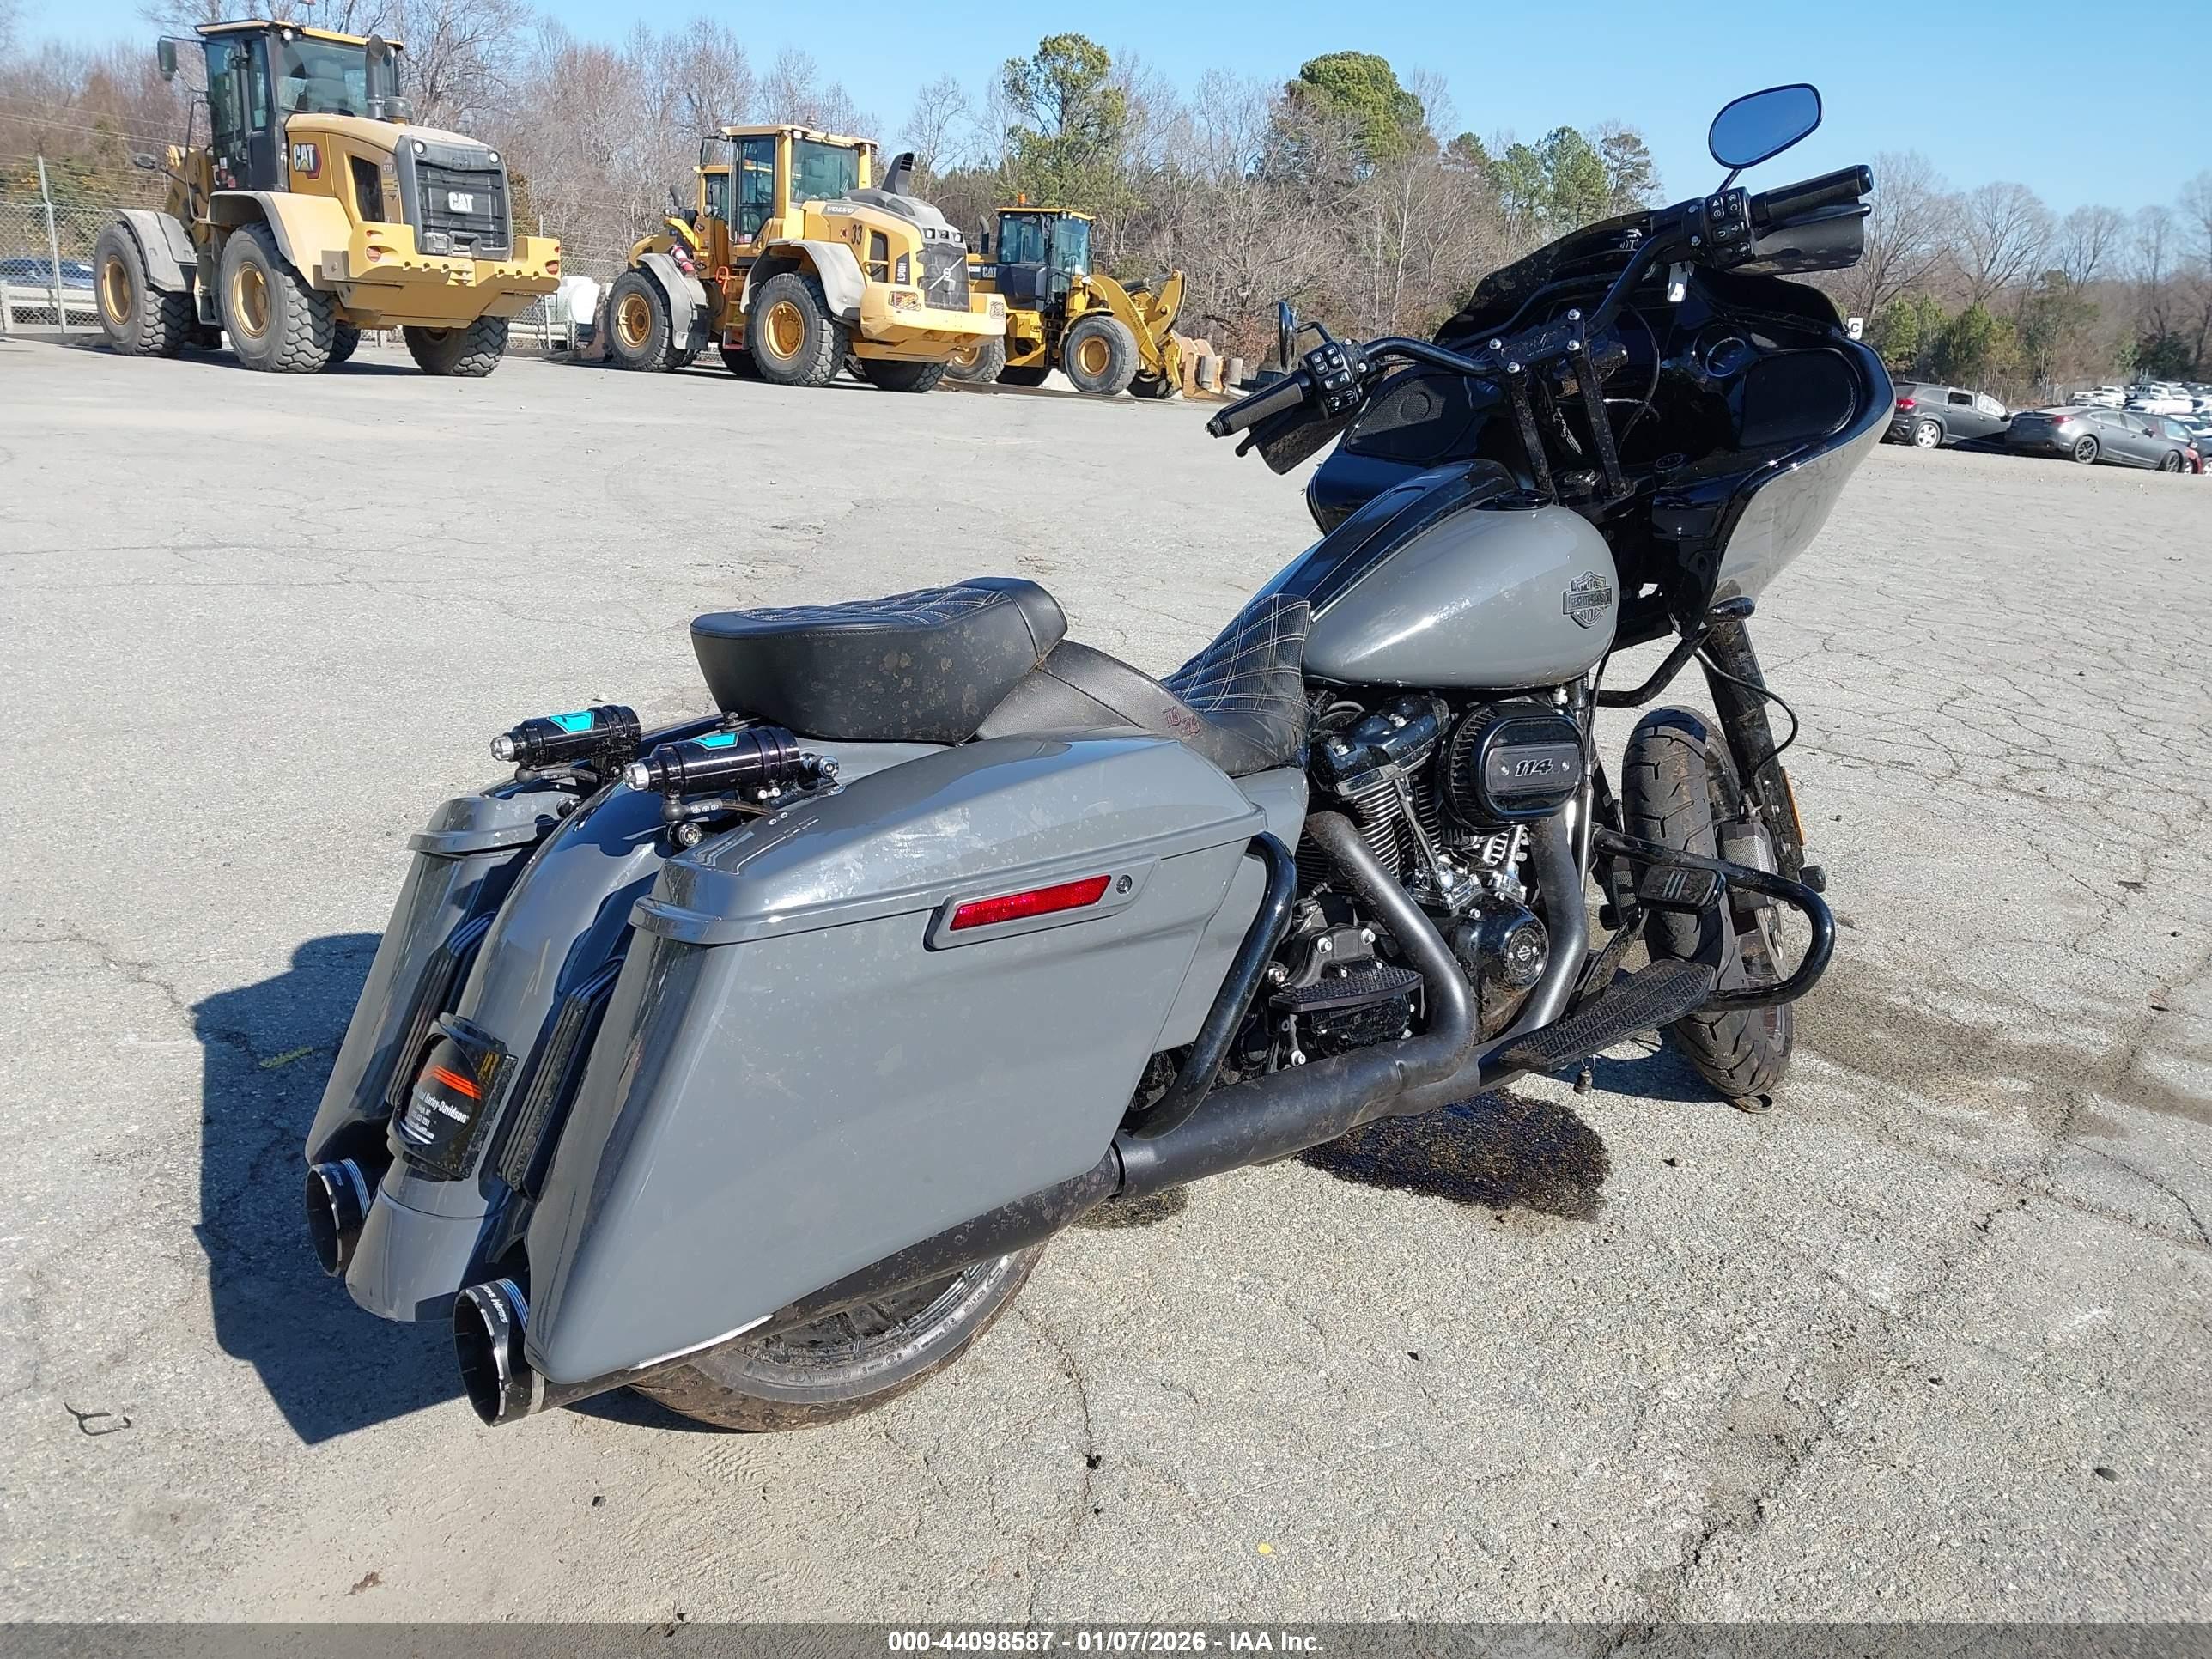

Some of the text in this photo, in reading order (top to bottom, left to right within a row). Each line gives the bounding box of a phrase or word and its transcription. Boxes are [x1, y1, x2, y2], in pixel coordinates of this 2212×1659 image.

[293, 144, 314, 171] CAT
[448, 191, 474, 213] CAT
[827, 205, 854, 214] VOLVO
[851, 224, 863, 246] 33
[896, 262, 907, 282] L90H
[982, 266, 997, 278] CAT
[1850, 323, 1860, 333] C
[1514, 757, 1554, 777] 114
[963, 1289, 987, 1313] ROTATION
